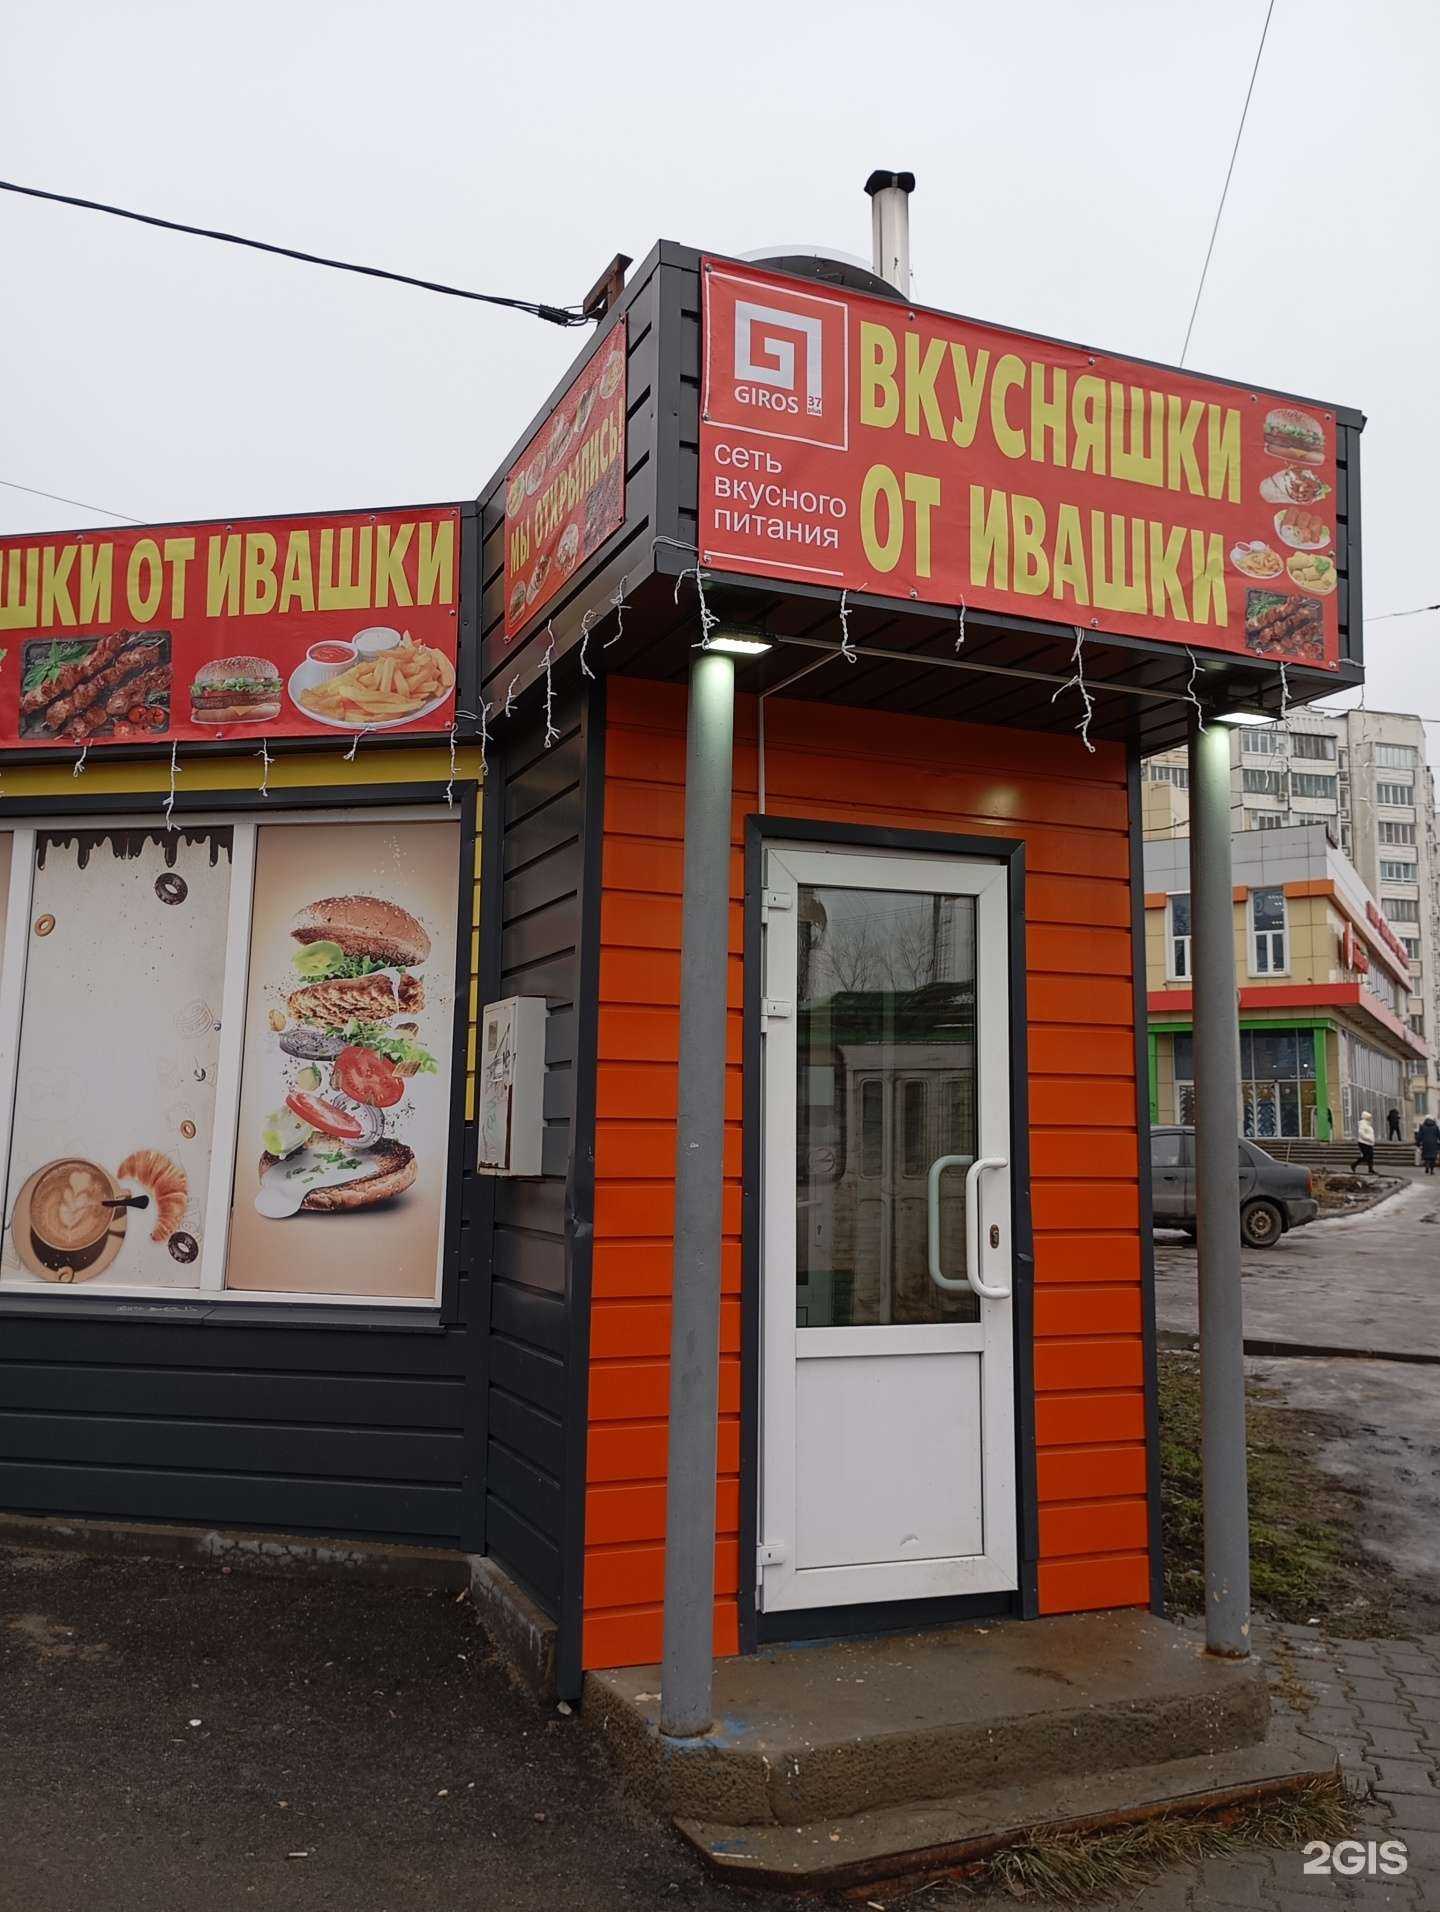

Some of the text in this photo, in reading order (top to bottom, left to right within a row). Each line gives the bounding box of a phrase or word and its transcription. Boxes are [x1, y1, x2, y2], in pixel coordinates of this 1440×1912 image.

[734, 386, 799, 414] GIROS
[807, 395, 822, 407] 37
[860, 321, 1242, 504] ВКУСНЯШКИ
[714, 444, 783, 474] сеть
[510, 397, 625, 577] МЫ ОТКРЫЛИСЬ!
[714, 475, 847, 518] вкусного
[714, 508, 839, 549] питания
[861, 463, 1229, 628] ОТ ИВАШКИ
[127, 537, 196, 623] ОТ
[206, 520, 455, 618] ИВАШКИ
